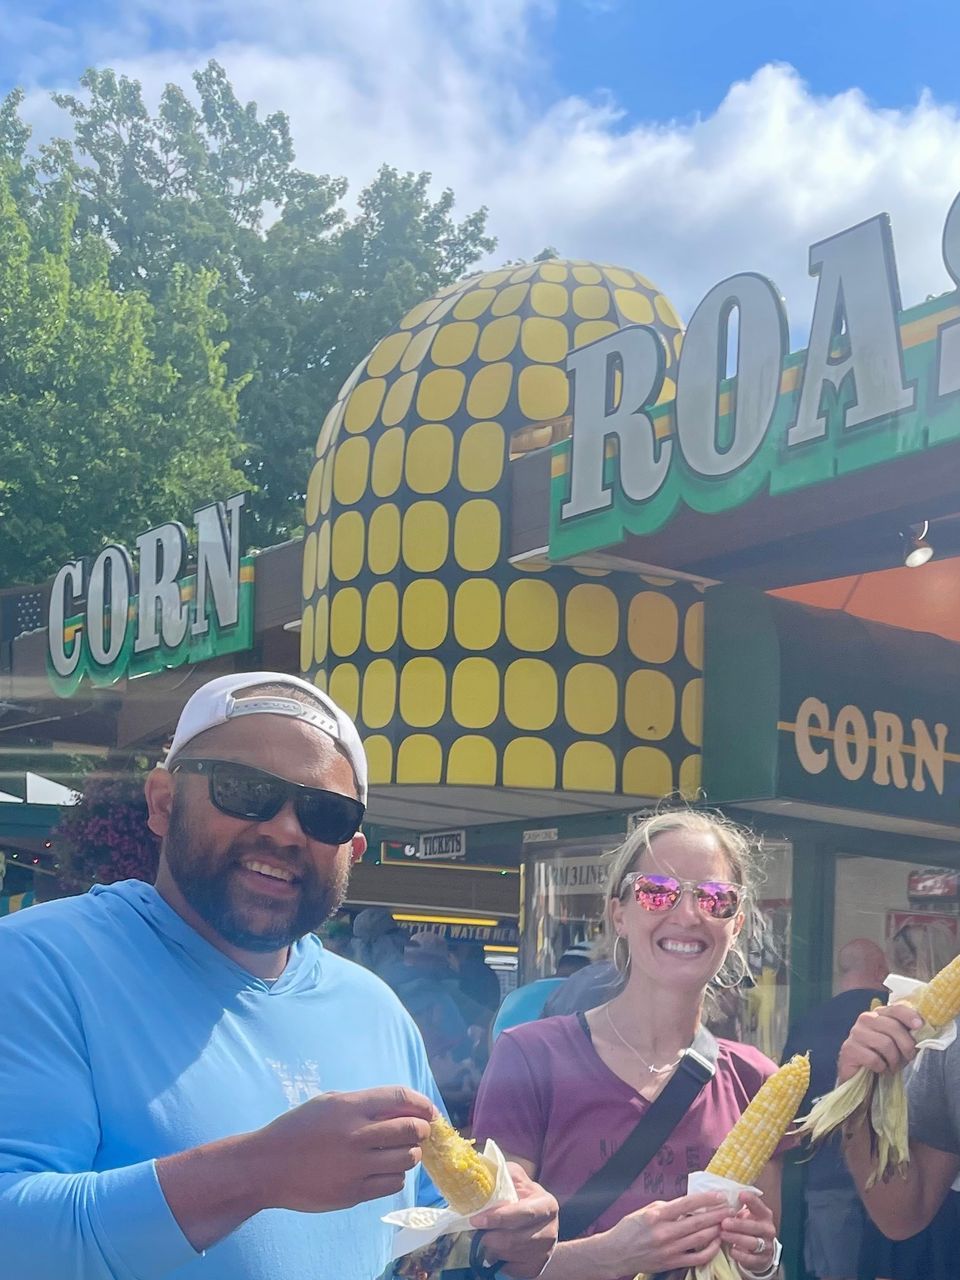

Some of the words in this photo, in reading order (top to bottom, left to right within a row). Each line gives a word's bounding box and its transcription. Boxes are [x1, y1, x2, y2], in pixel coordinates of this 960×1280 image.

[48, 491, 246, 677] CORN
[794, 697, 949, 796] CORN
[423, 833, 462, 857] TICKETS
[569, 866, 578, 886] 3
[451, 925, 490, 940] WATER
